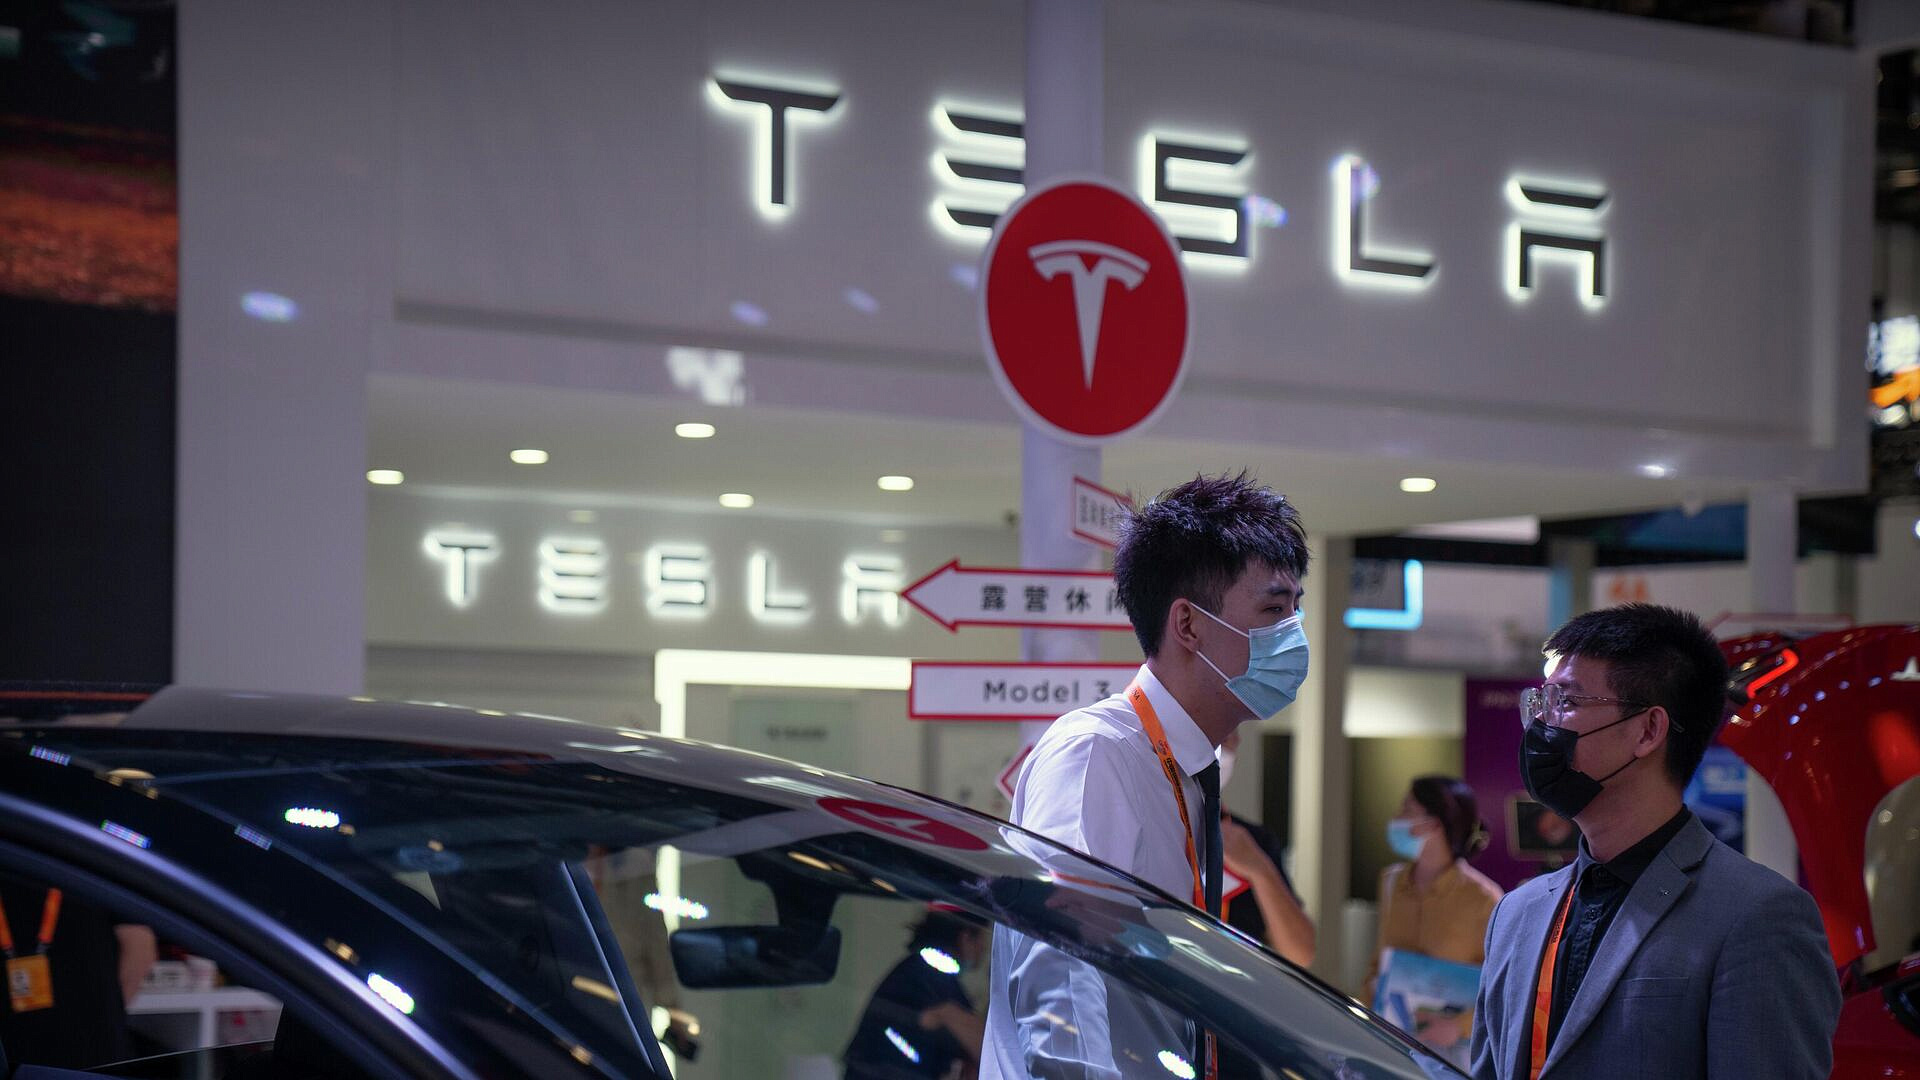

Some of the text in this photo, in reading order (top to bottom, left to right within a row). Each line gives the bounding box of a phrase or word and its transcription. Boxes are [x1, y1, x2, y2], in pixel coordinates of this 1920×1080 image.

[709, 72, 1610, 305] TESLA
[424, 532, 907, 622] TESLA
[983, 681, 1079, 703] Model
[1096, 681, 1110, 701] 3
